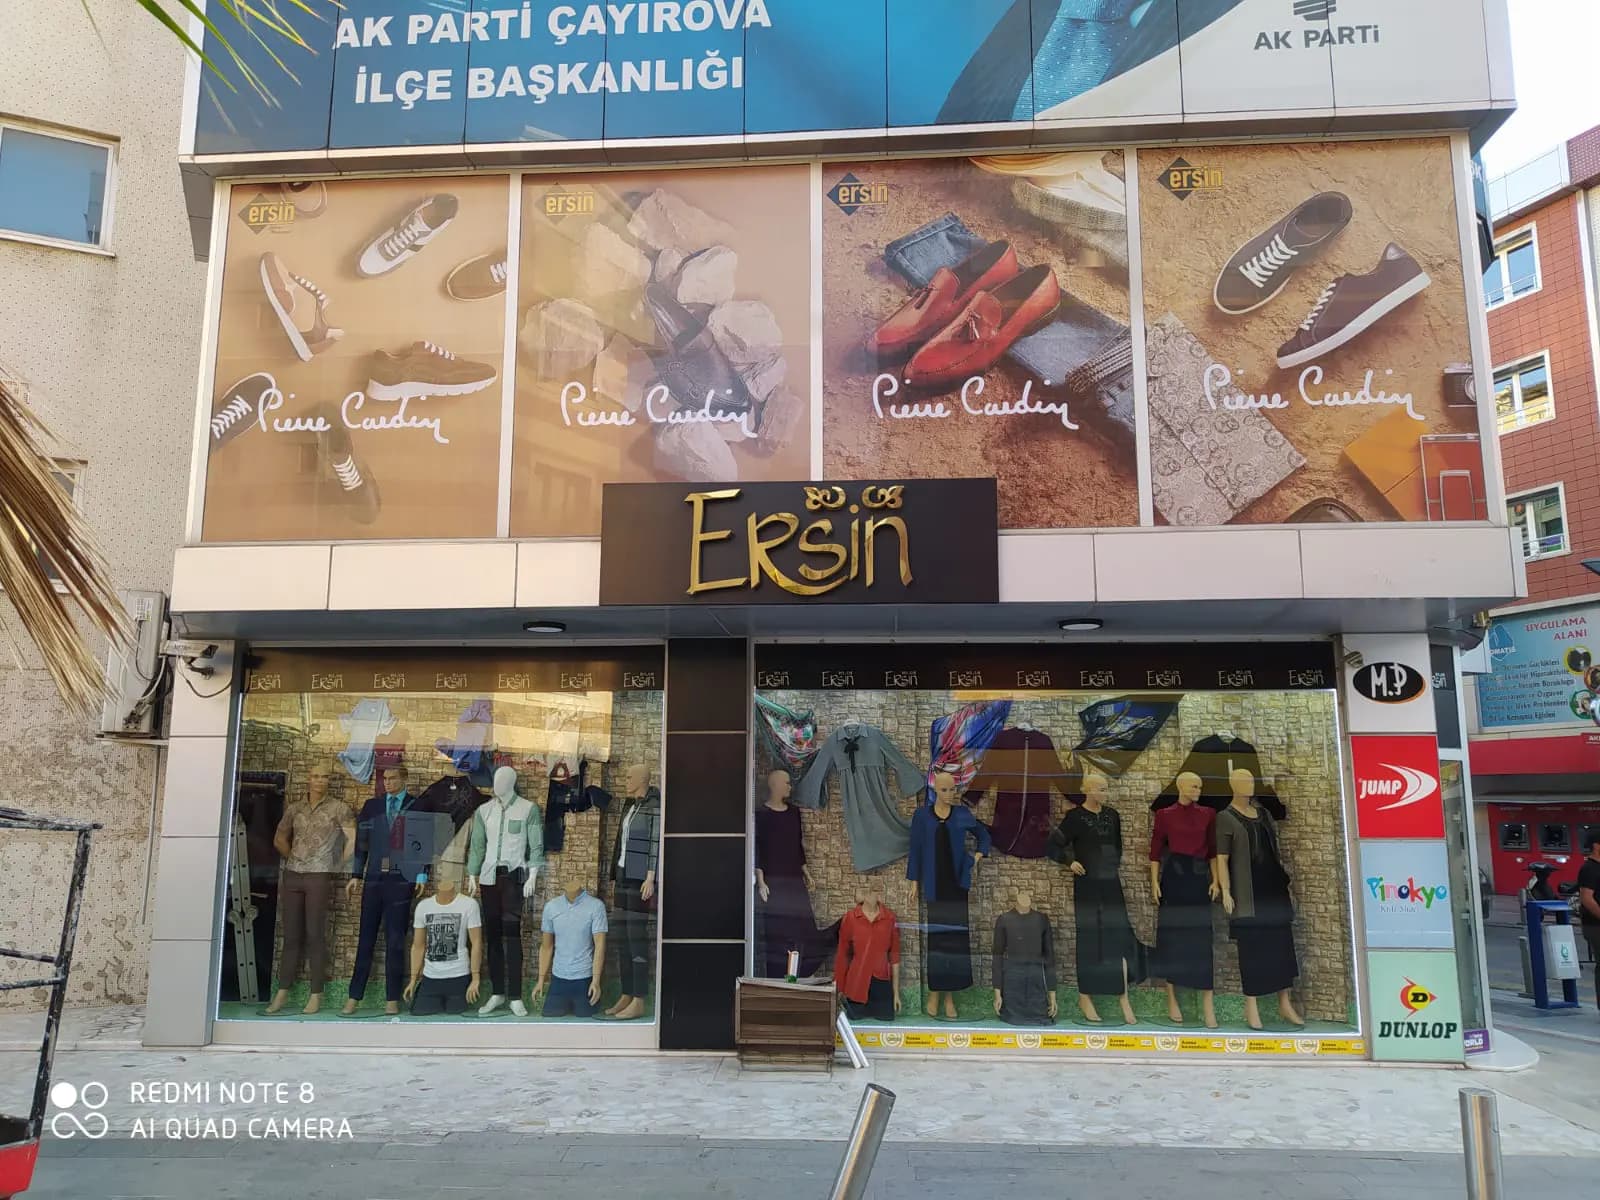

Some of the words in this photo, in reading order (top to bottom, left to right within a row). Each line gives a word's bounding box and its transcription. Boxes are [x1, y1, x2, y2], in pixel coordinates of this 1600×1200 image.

[332, 15, 394, 50] AK
[407, 1, 531, 45] PARTİ
[548, 0, 772, 45] ÇAYIROVA
[1254, 30, 1292, 50] AK
[355, 66, 452, 109] İLÇE
[468, 49, 743, 104] BAŞKANLIĞI
[1169, 166, 1223, 189] ersin
[546, 192, 594, 213] ersin
[839, 181, 888, 203] ersin
[248, 201, 296, 223] ersin
[961, 376, 1079, 430] Cardin
[1299, 365, 1425, 420] Cardin
[341, 391, 450, 443] Cardin
[646, 385, 758, 438] Cardin
[1525, 617, 1587, 632] UYGULAMA
[1553, 629, 1588, 640] ALANI
[1359, 778, 1402, 799] JUMP
[1366, 876, 1447, 909] Pinokyo
[1411, 992, 1428, 1003] D
[1378, 1021, 1458, 1039] DUNLOP
